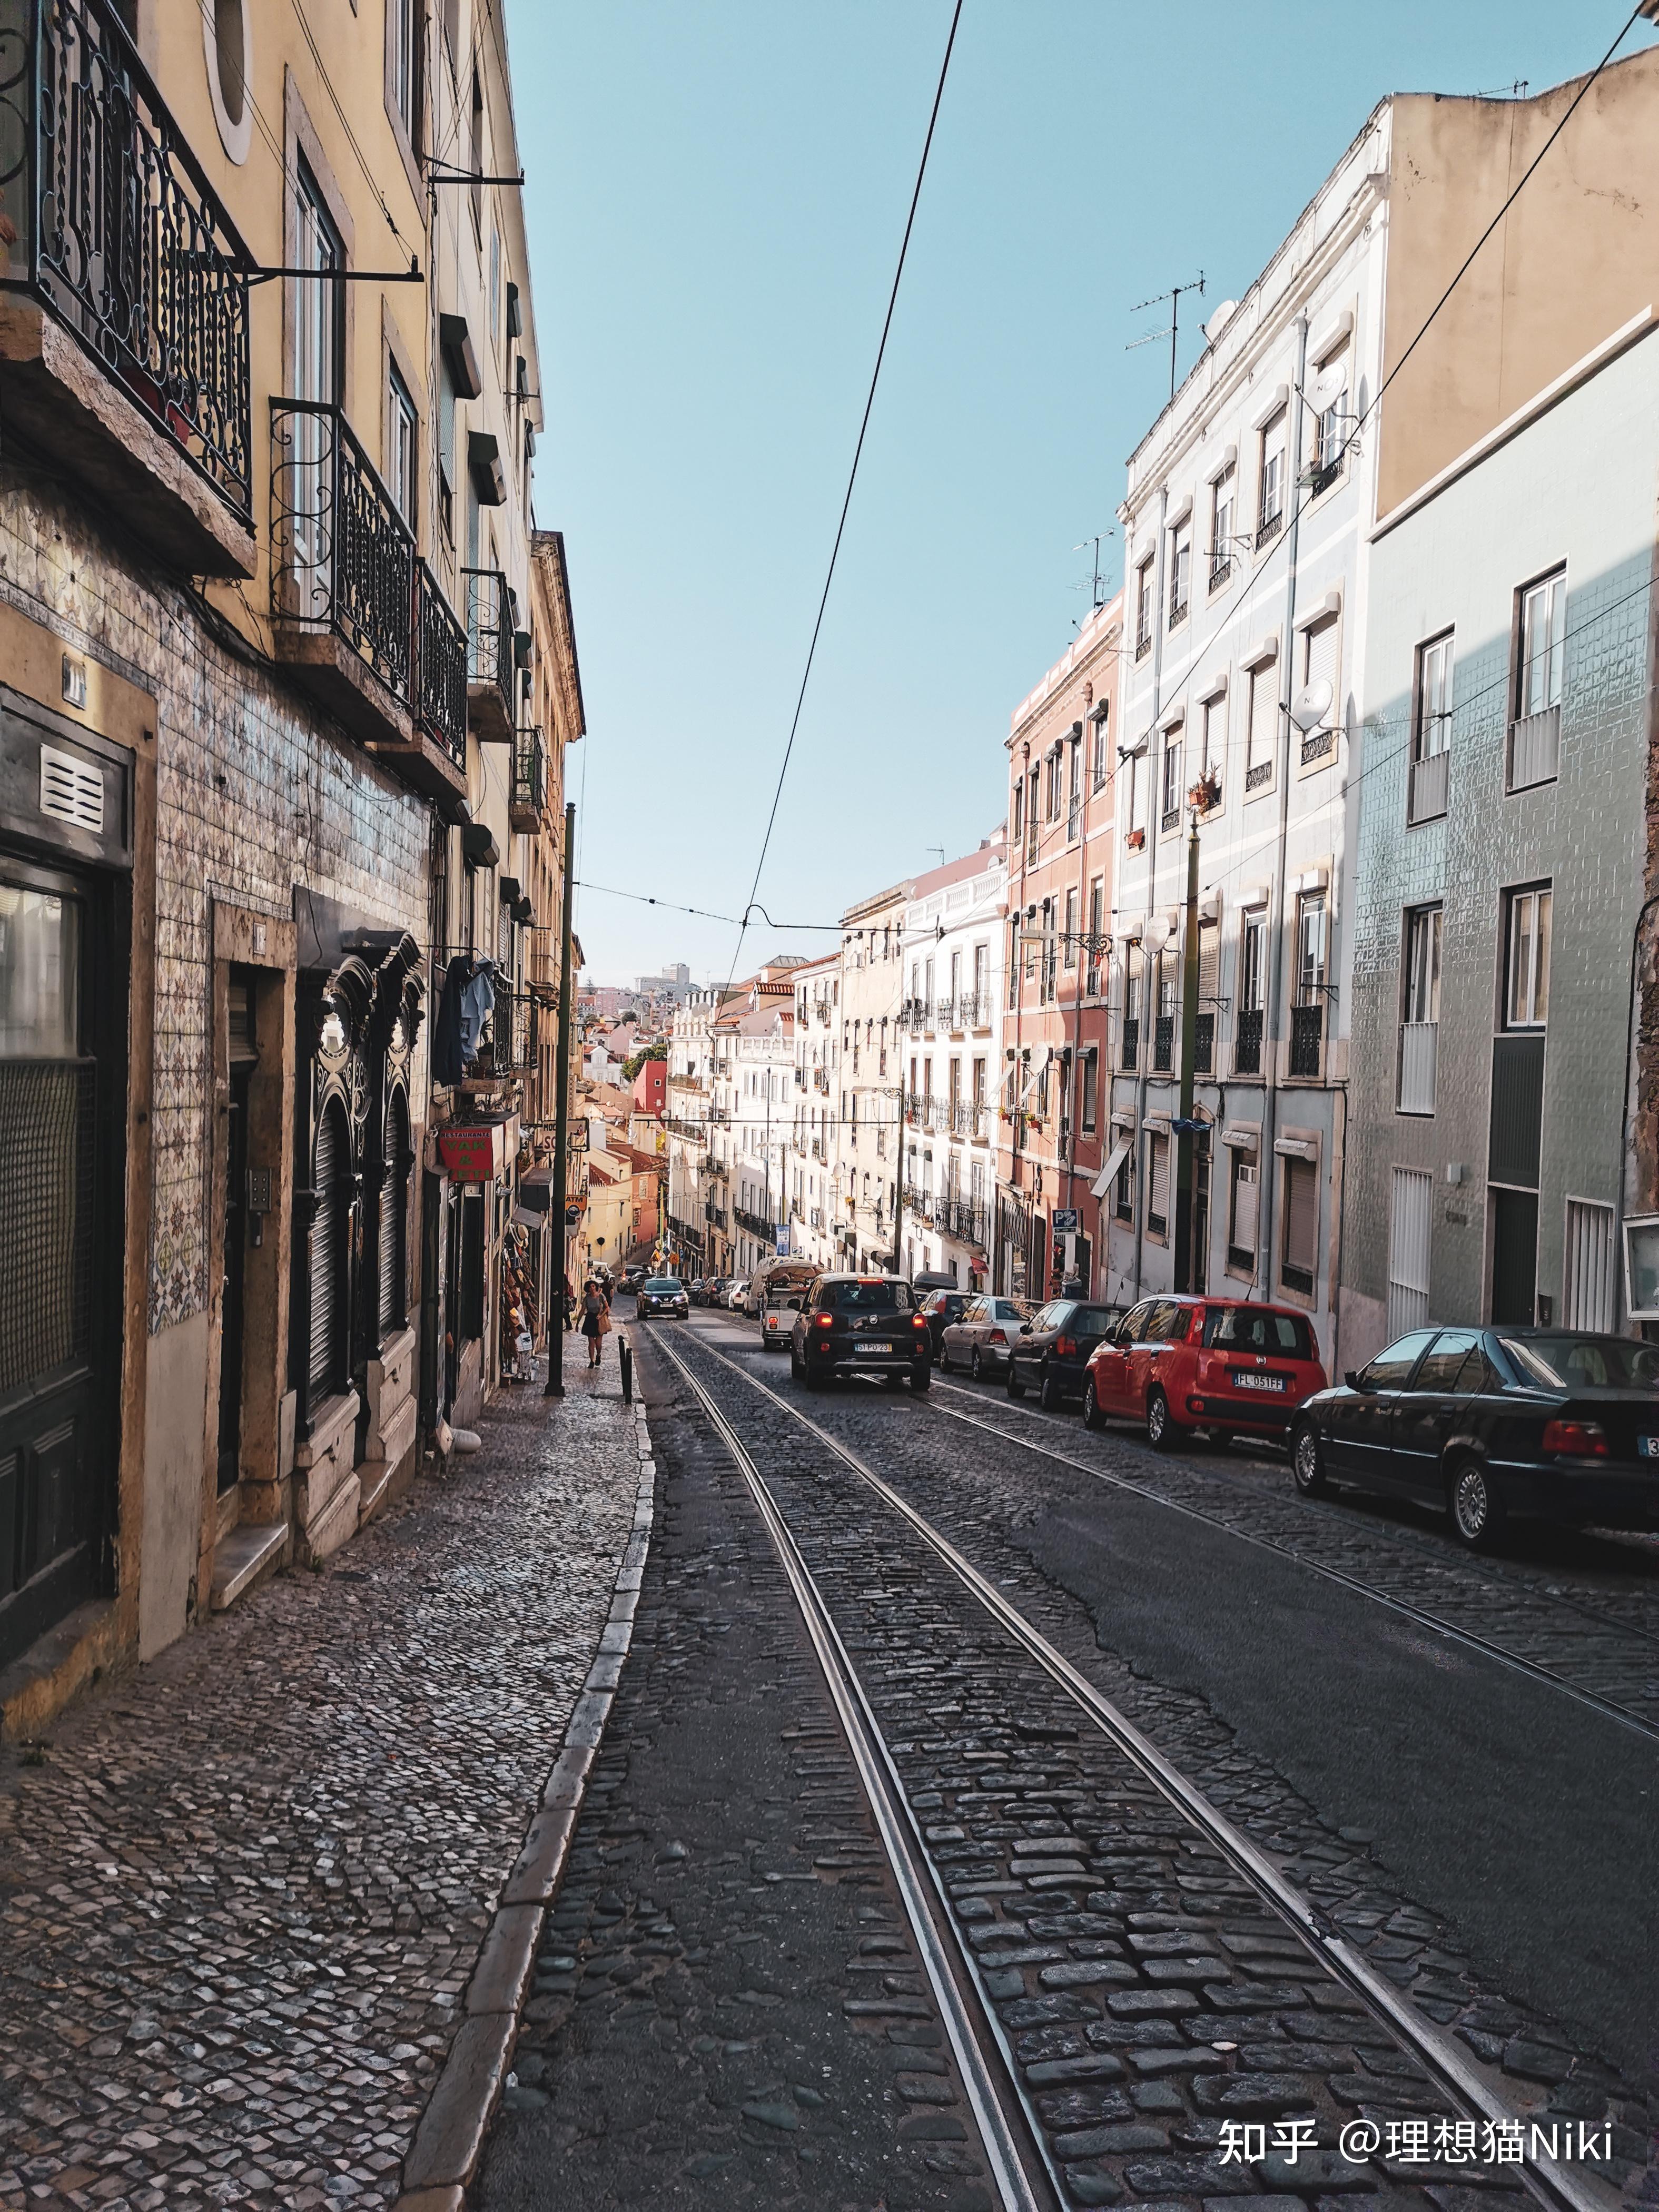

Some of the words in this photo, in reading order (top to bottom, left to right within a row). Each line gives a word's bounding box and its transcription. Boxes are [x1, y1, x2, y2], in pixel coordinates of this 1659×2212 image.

[446, 1140, 486, 1151] YAK
[1055, 1212, 1064, 1224] P
[1240, 1375, 1251, 1385] FL
[1254, 1376, 1281, 1388] 051FF
